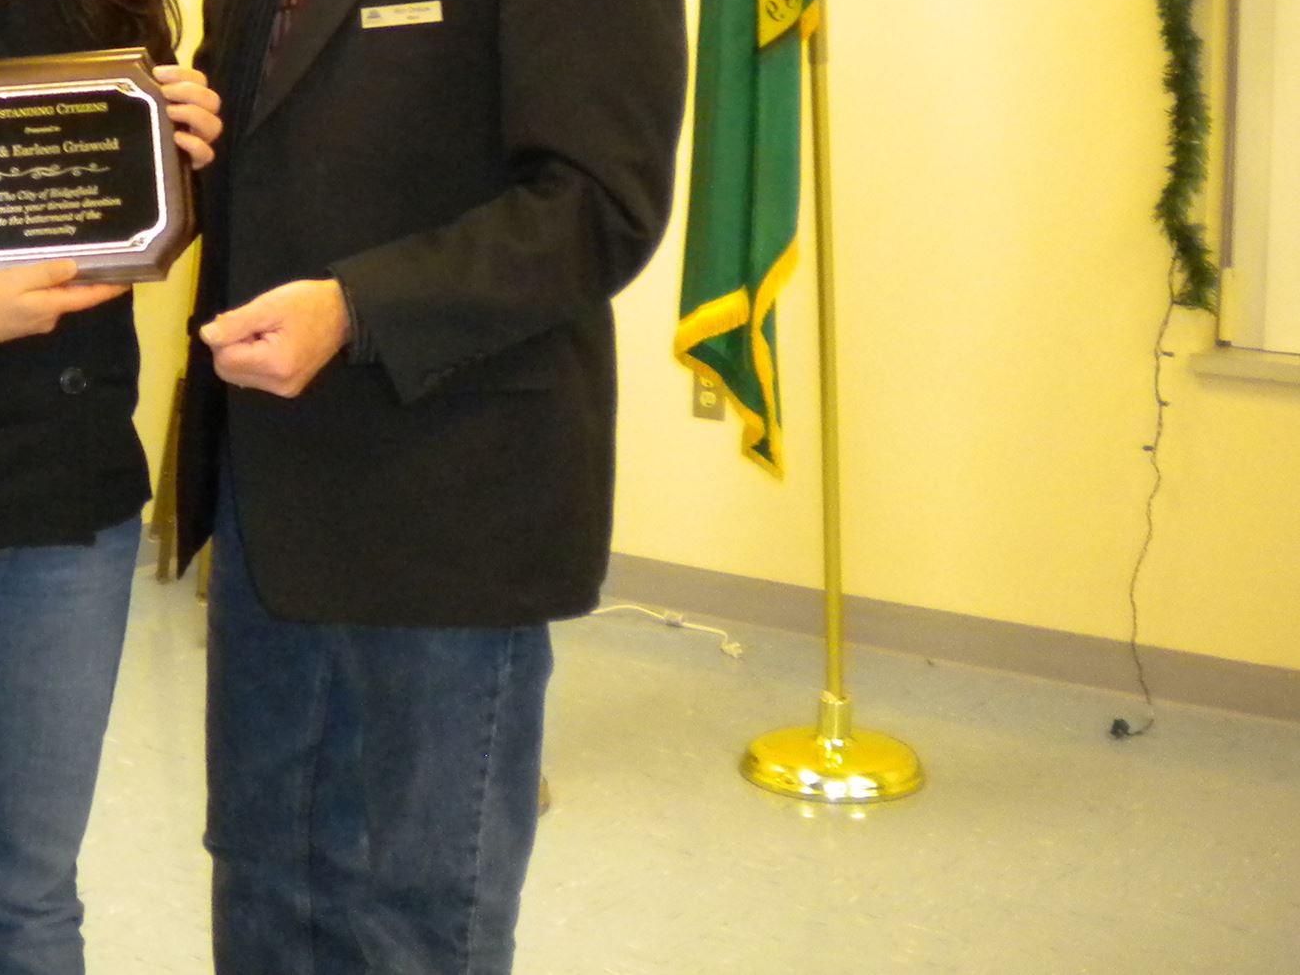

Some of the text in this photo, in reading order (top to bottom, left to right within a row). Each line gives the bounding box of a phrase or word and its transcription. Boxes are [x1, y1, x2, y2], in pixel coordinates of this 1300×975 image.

[56, 102, 108, 115] CITIZENS
[62, 137, 119, 153] Griswold
[17, 190, 38, 201] City
[38, 188, 48, 199] of
[8, 216, 24, 225] the
[74, 211, 84, 222] of
[23, 225, 76, 236] community
